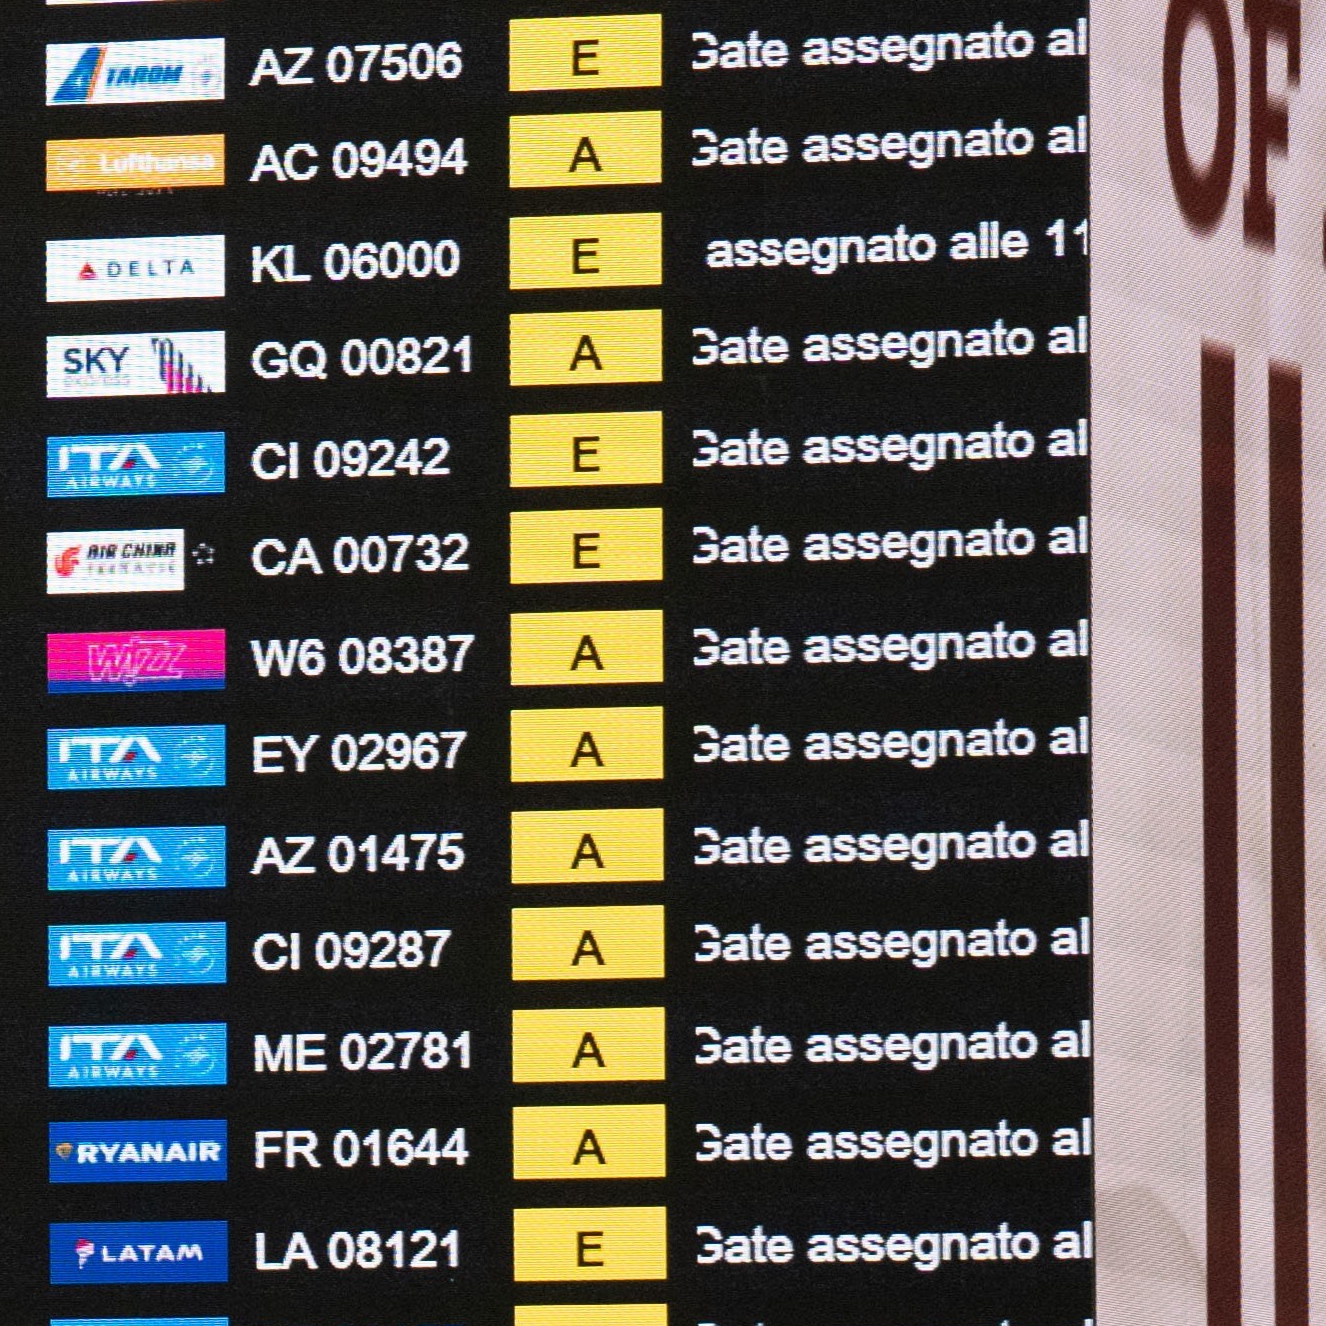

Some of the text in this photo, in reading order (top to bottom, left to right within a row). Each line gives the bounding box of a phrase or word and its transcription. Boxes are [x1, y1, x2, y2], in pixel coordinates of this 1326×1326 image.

[249, 41, 462, 86] AZ 07506
[250, 138, 468, 181] AC 09494
[252, 240, 460, 283] KL 06000
[64, 346, 130, 374] SKY
[252, 336, 470, 379] GQ 00821
[252, 438, 450, 480] CI 09242
[252, 533, 469, 576] CA 00732
[250, 635, 474, 677] W6 08387
[254, 731, 467, 773] EY 02967
[251, 833, 465, 874] AZ 01475
[253, 930, 451, 970] CI 09287
[255, 1031, 470, 1072] ME 02781
[77, 1141, 221, 1164] RYANAIR
[256, 1128, 469, 1168] FR 01644
[102, 1243, 203, 1263] LATAM
[256, 1230, 458, 1270] LA 08121
